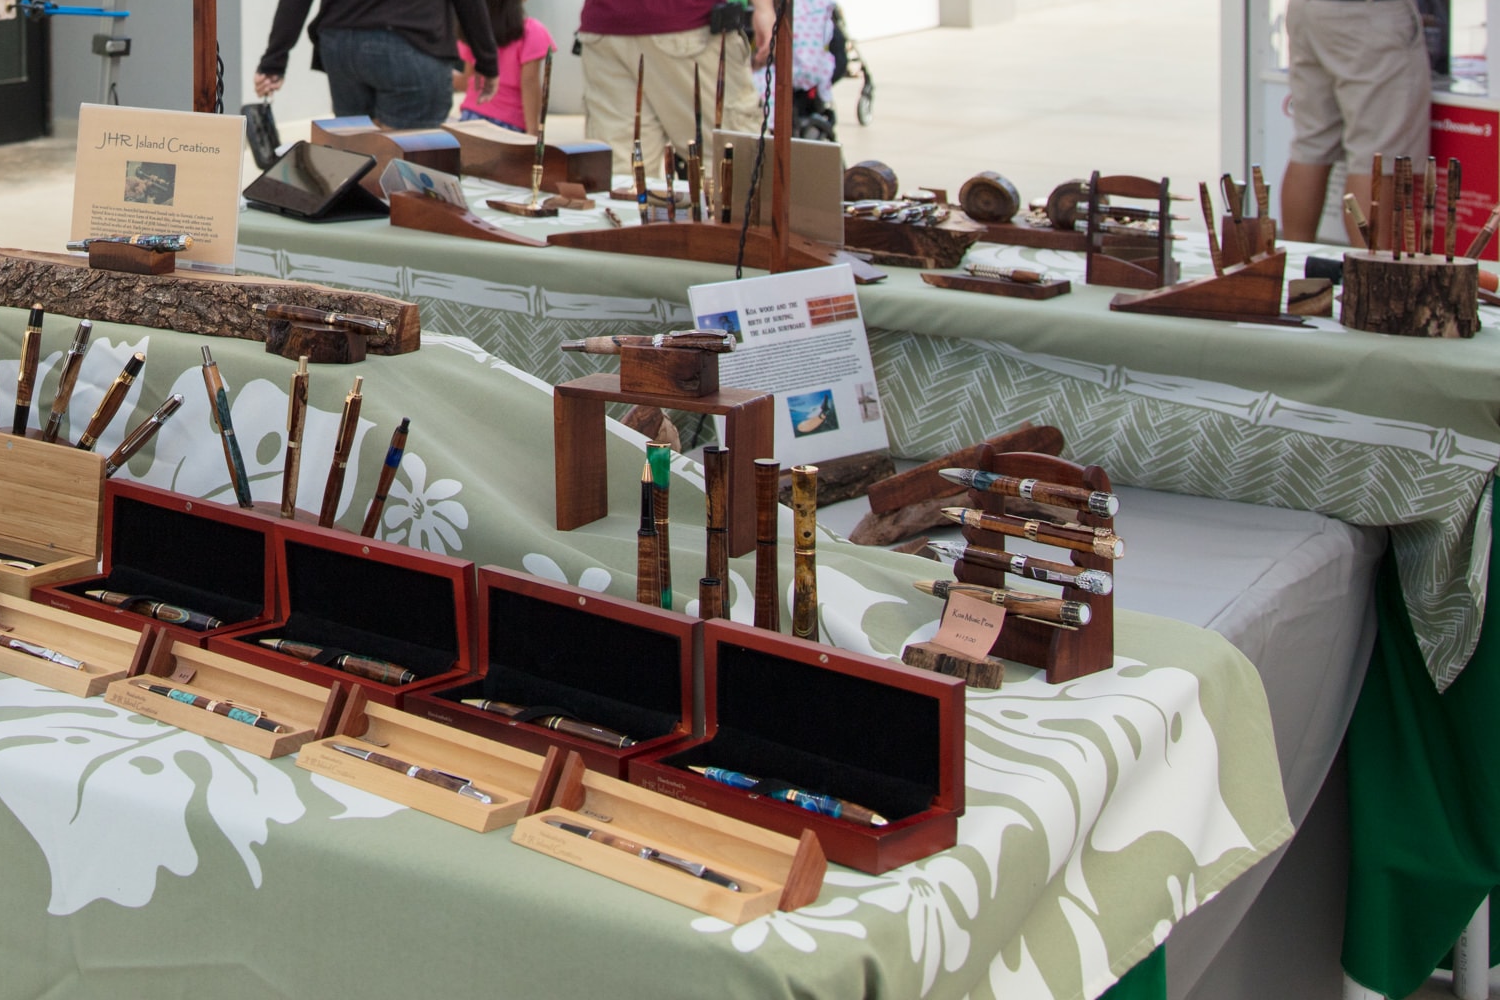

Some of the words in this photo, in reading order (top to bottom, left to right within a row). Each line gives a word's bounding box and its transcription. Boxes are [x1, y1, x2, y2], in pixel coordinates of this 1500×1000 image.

[1443, 118, 1483, 136] December
[95, 132, 132, 149] JHR
[135, 135, 165, 149] Island
[167, 137, 220, 154] Creations
